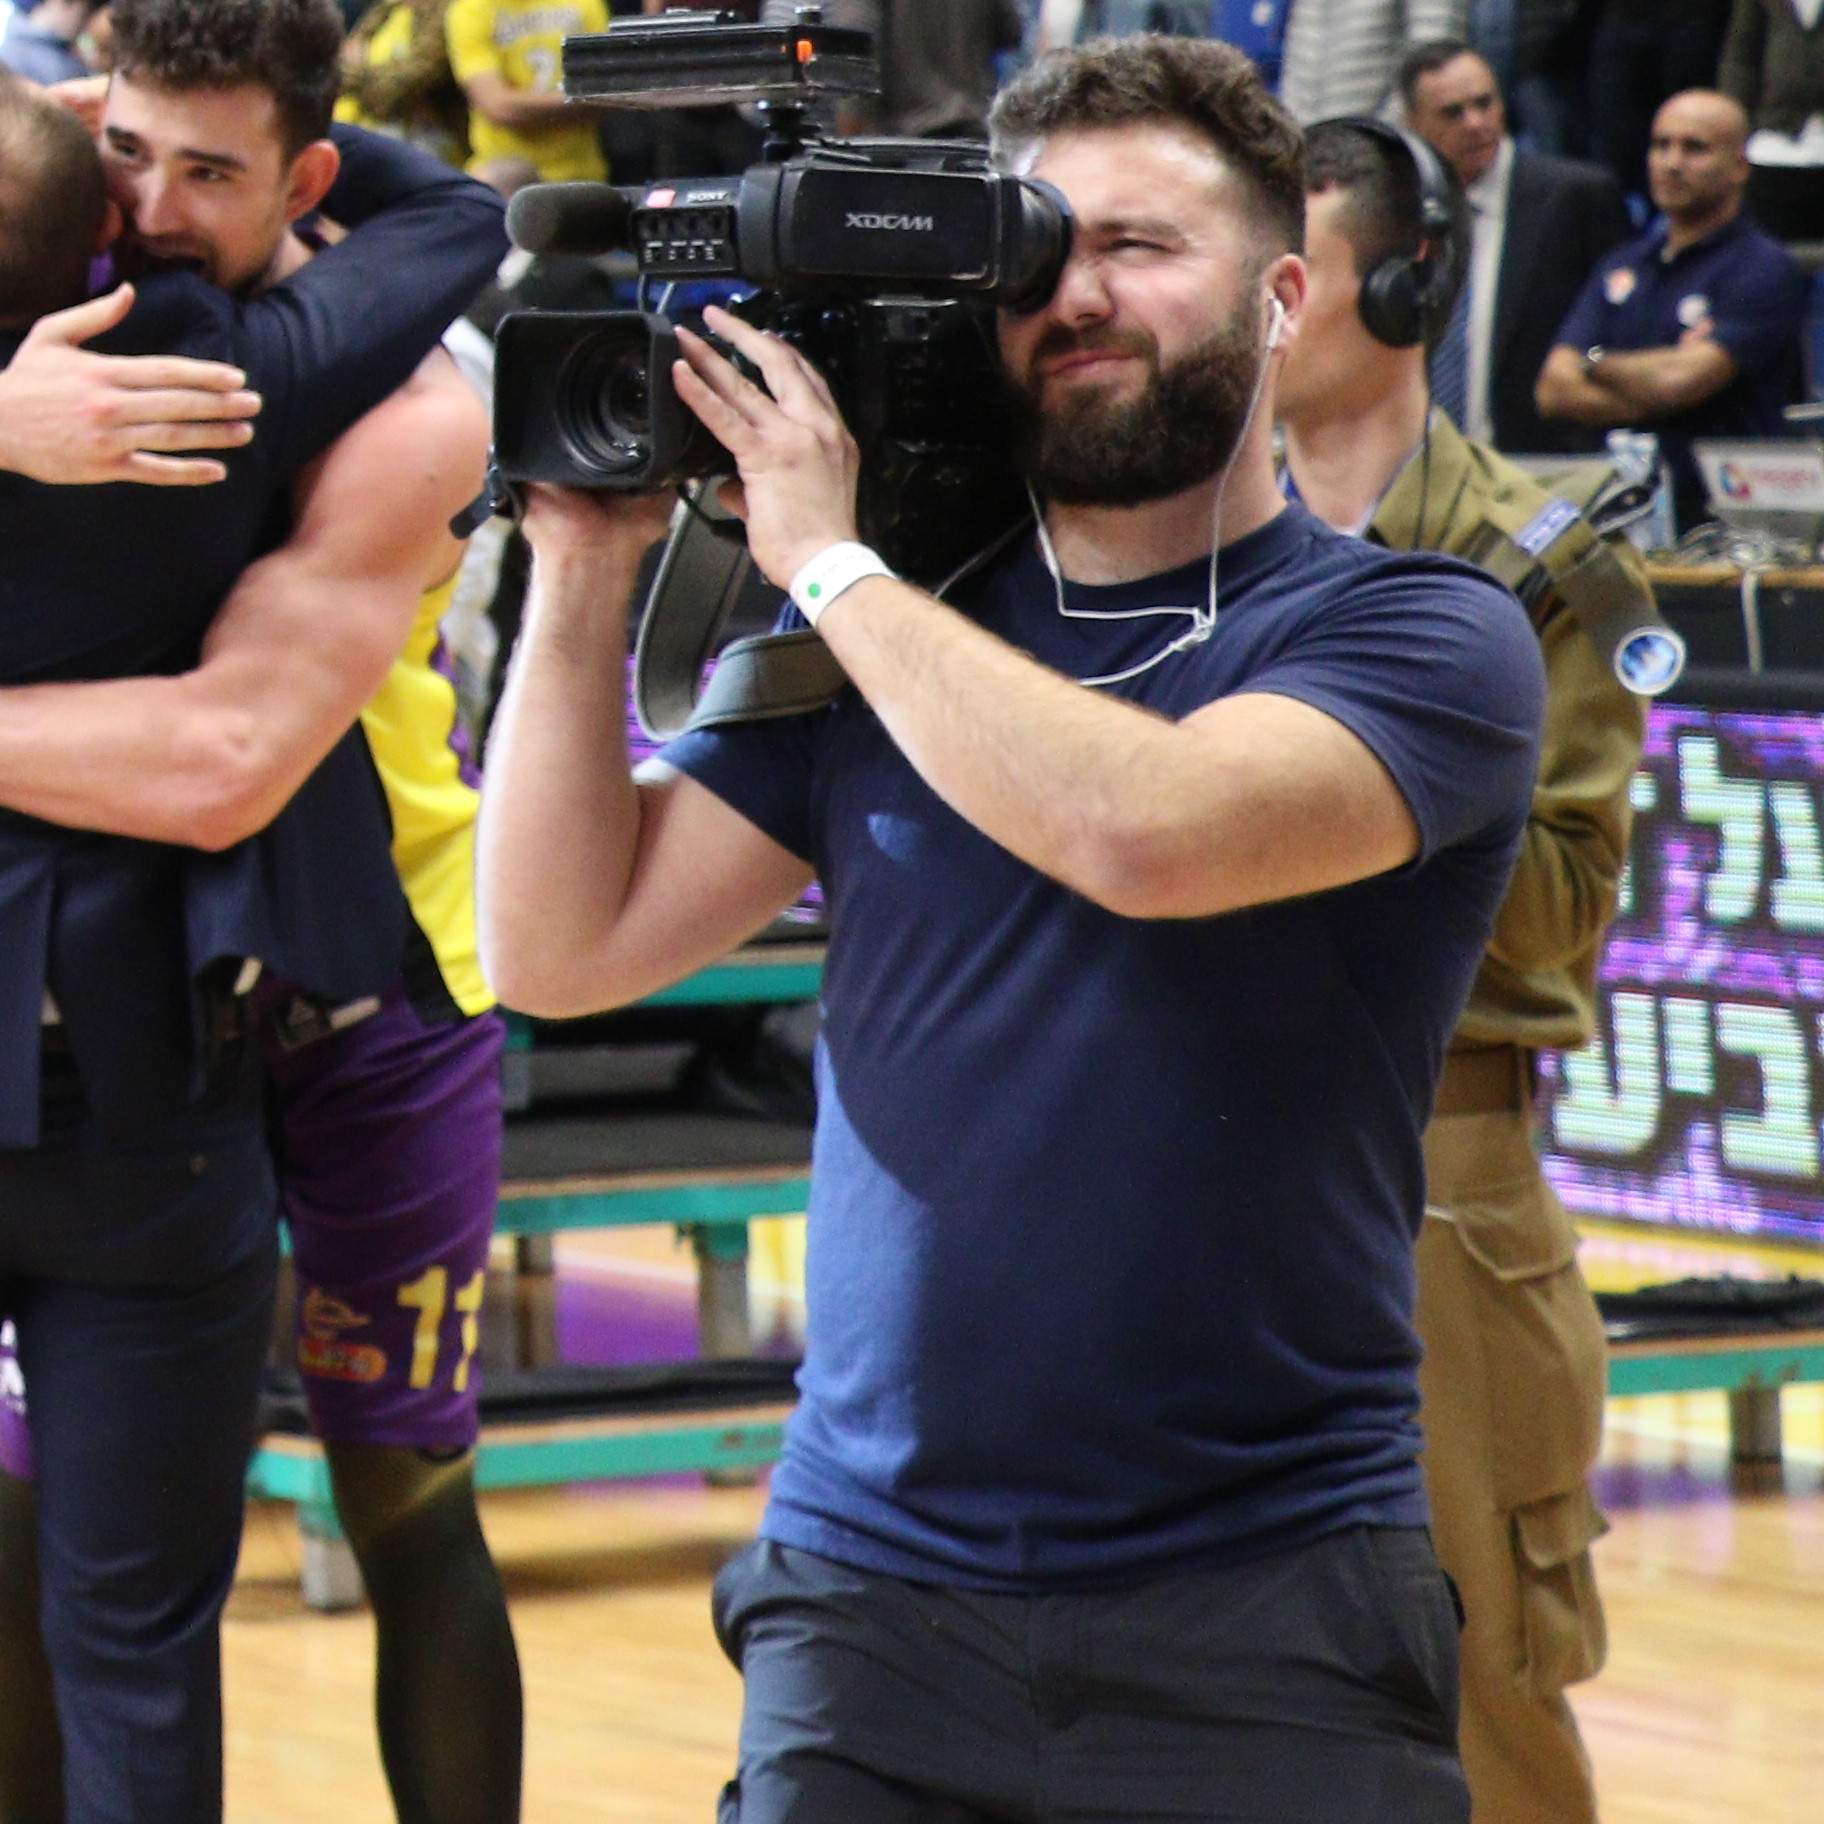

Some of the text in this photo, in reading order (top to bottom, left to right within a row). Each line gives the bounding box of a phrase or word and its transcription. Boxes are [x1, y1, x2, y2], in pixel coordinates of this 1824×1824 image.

[844, 211, 934, 233] XDCAM
[1554, 991, 1824, 1179] ביע
[396, 1265, 485, 1393] 11
